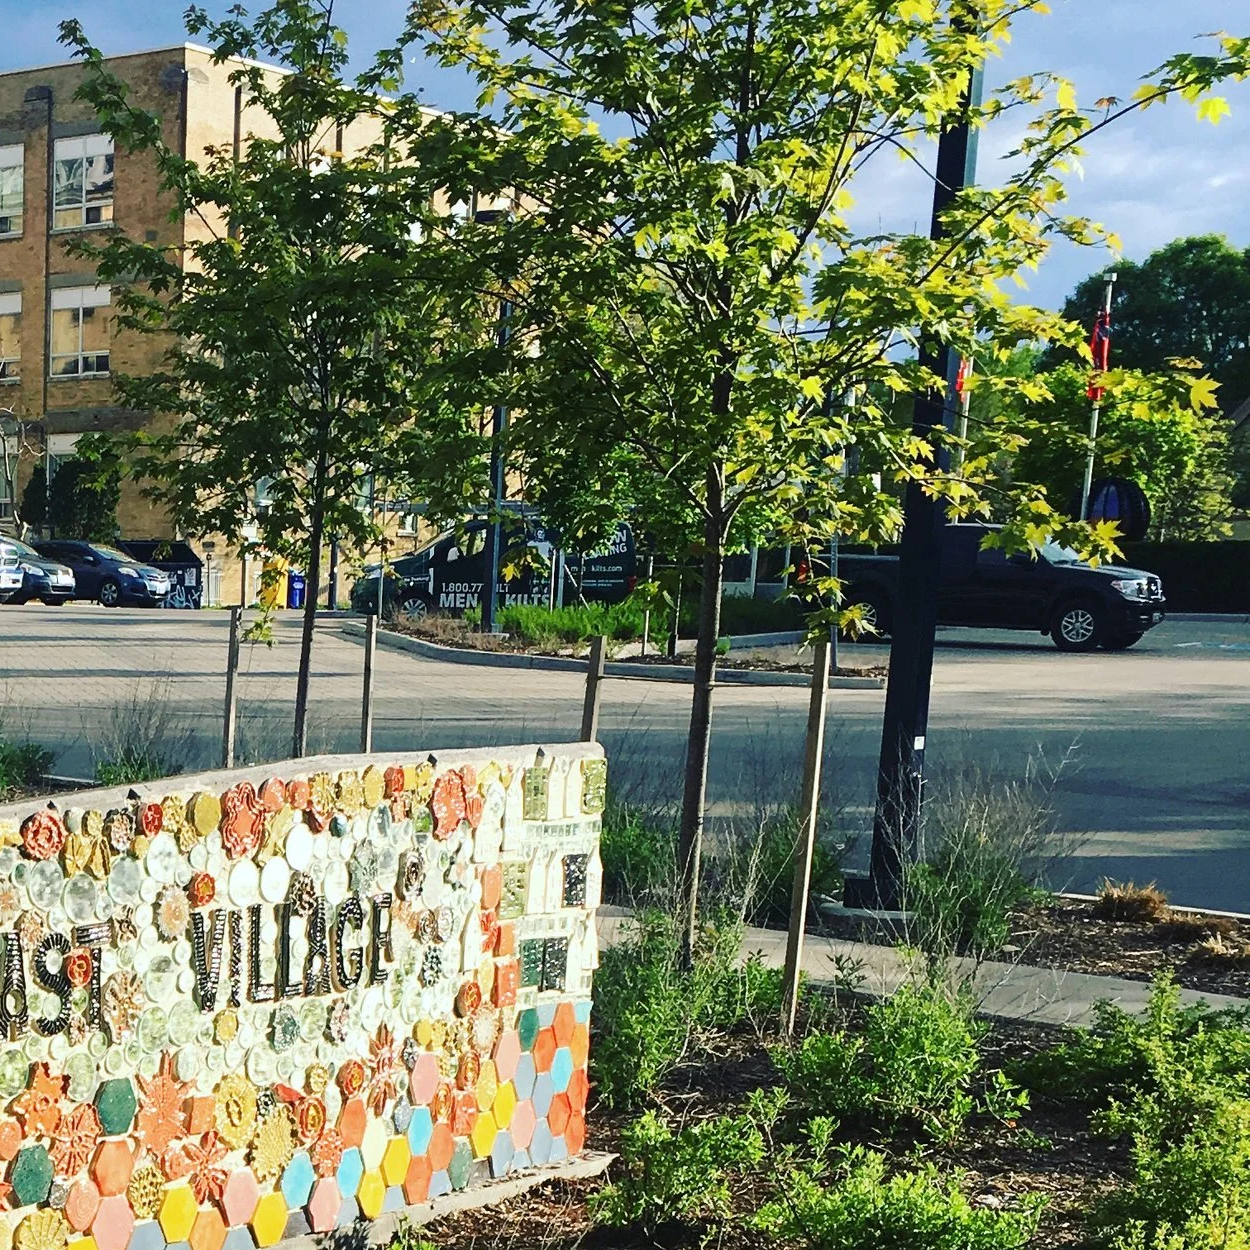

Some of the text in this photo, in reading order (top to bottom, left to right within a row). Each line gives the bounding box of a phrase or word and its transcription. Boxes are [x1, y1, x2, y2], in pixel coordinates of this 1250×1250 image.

[439, 593, 550, 608] MEN KILTS
[191, 892, 392, 1013] VILLAGE
